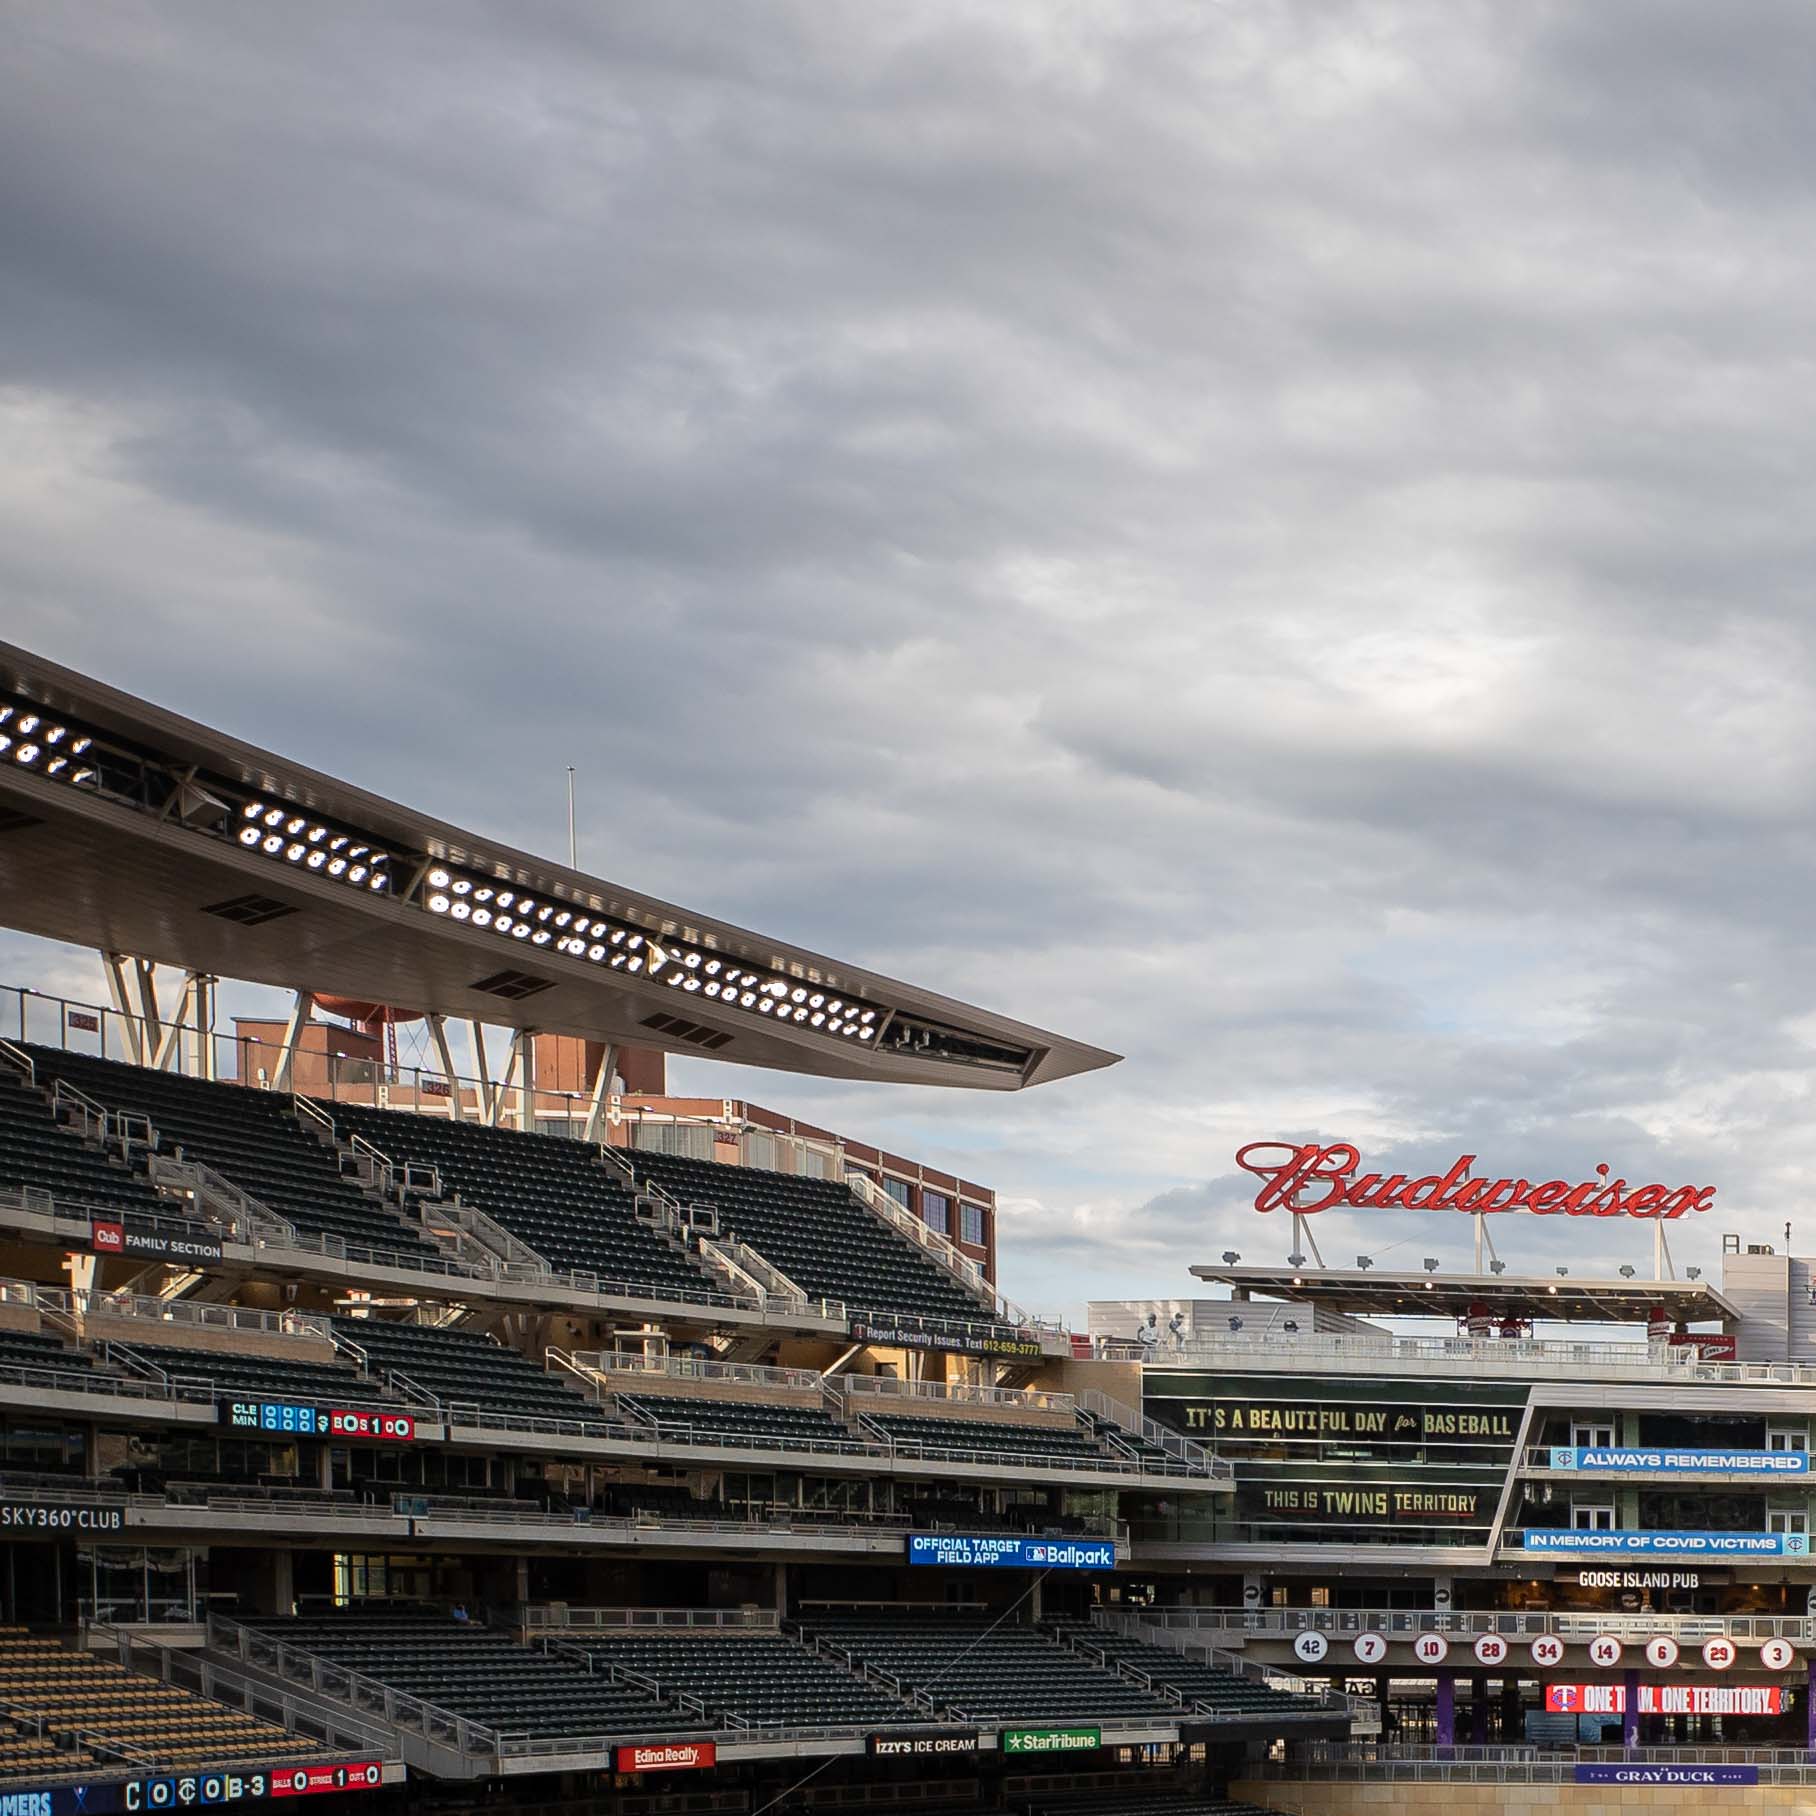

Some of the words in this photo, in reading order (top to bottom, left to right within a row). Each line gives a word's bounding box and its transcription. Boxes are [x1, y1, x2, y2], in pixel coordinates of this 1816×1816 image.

[1236, 1141, 1717, 1218] Budweiser
[97, 1230, 120, 1244] Cub
[126, 1235, 168, 1250] FAMILY
[171, 1241, 220, 1258] SECTION
[232, 1403, 257, 1415] CLE
[232, 1415, 257, 1426] MIN
[1186, 1408, 1225, 1428] IT'S
[1232, 1409, 1243, 1428] A
[1250, 1409, 1349, 1432] BEAUTIFUL
[1355, 1412, 1387, 1432] DAY
[1395, 1413, 1416, 1431] for
[1424, 1412, 1511, 1435] BASEBALL
[1583, 1453, 1661, 1467] ALWAYS
[1665, 1454, 1802, 1469] REMEMBERED
[1265, 1490, 1298, 1508] THIS
[1303, 1492, 1318, 1509] IS
[1323, 1492, 1387, 1514] TWINS
[1395, 1493, 1477, 1512] TERRITORY
[914, 1538, 967, 1550] OFFICIAL
[973, 1540, 1020, 1552] TARGET
[1530, 1535, 1546, 1545] IN
[1551, 1535, 1624, 1547] MEMORY
[1628, 1537, 1650, 1547] OF
[1653, 1537, 1705, 1548] COVID
[1709, 1538, 1776, 1549] VICTIMS
[937, 1552, 972, 1563] FIELD
[974, 1552, 999, 1564] APP
[1048, 1547, 1110, 1567] Ballpark
[1579, 1571, 1621, 1588] GOOSE
[1623, 1572, 1670, 1588] ISLAND
[1673, 1573, 1699, 1588] PUB
[1598, 1645, 1612, 1659] 14
